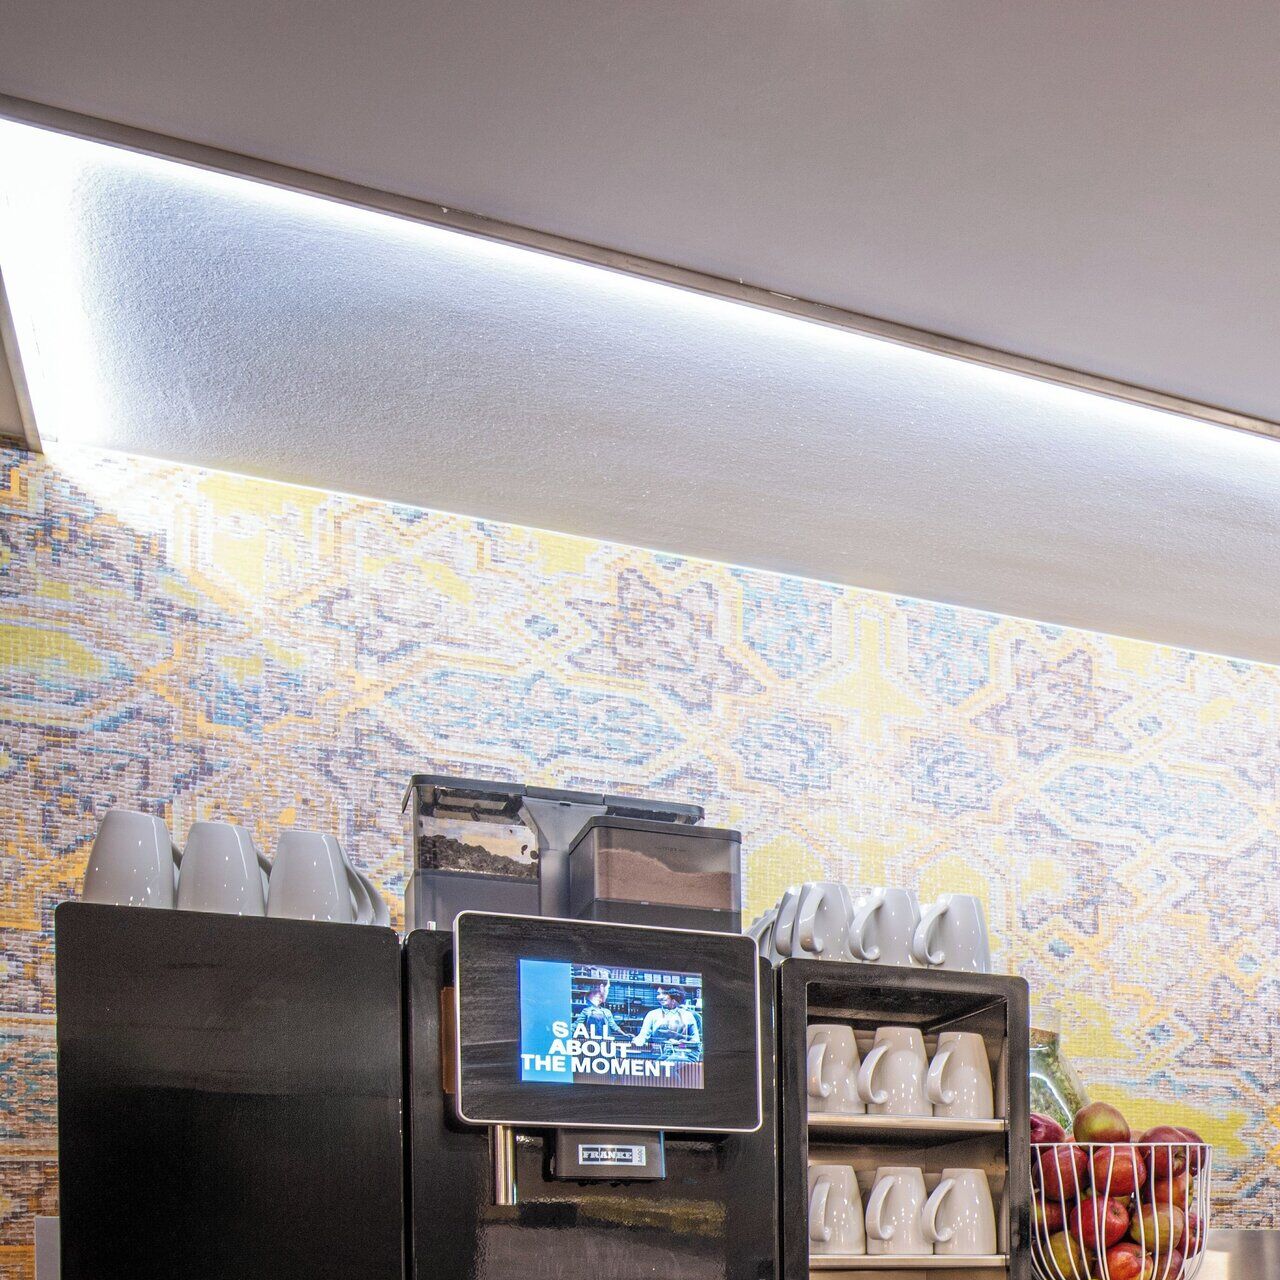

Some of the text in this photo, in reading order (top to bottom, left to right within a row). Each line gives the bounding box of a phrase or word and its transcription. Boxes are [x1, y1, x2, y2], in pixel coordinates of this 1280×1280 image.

[572, 1023, 615, 1041] ALL
[548, 1038, 631, 1059] ABOUT
[521, 1053, 675, 1077] THE MOMENT
[582, 1150, 633, 1160] FRANKE
